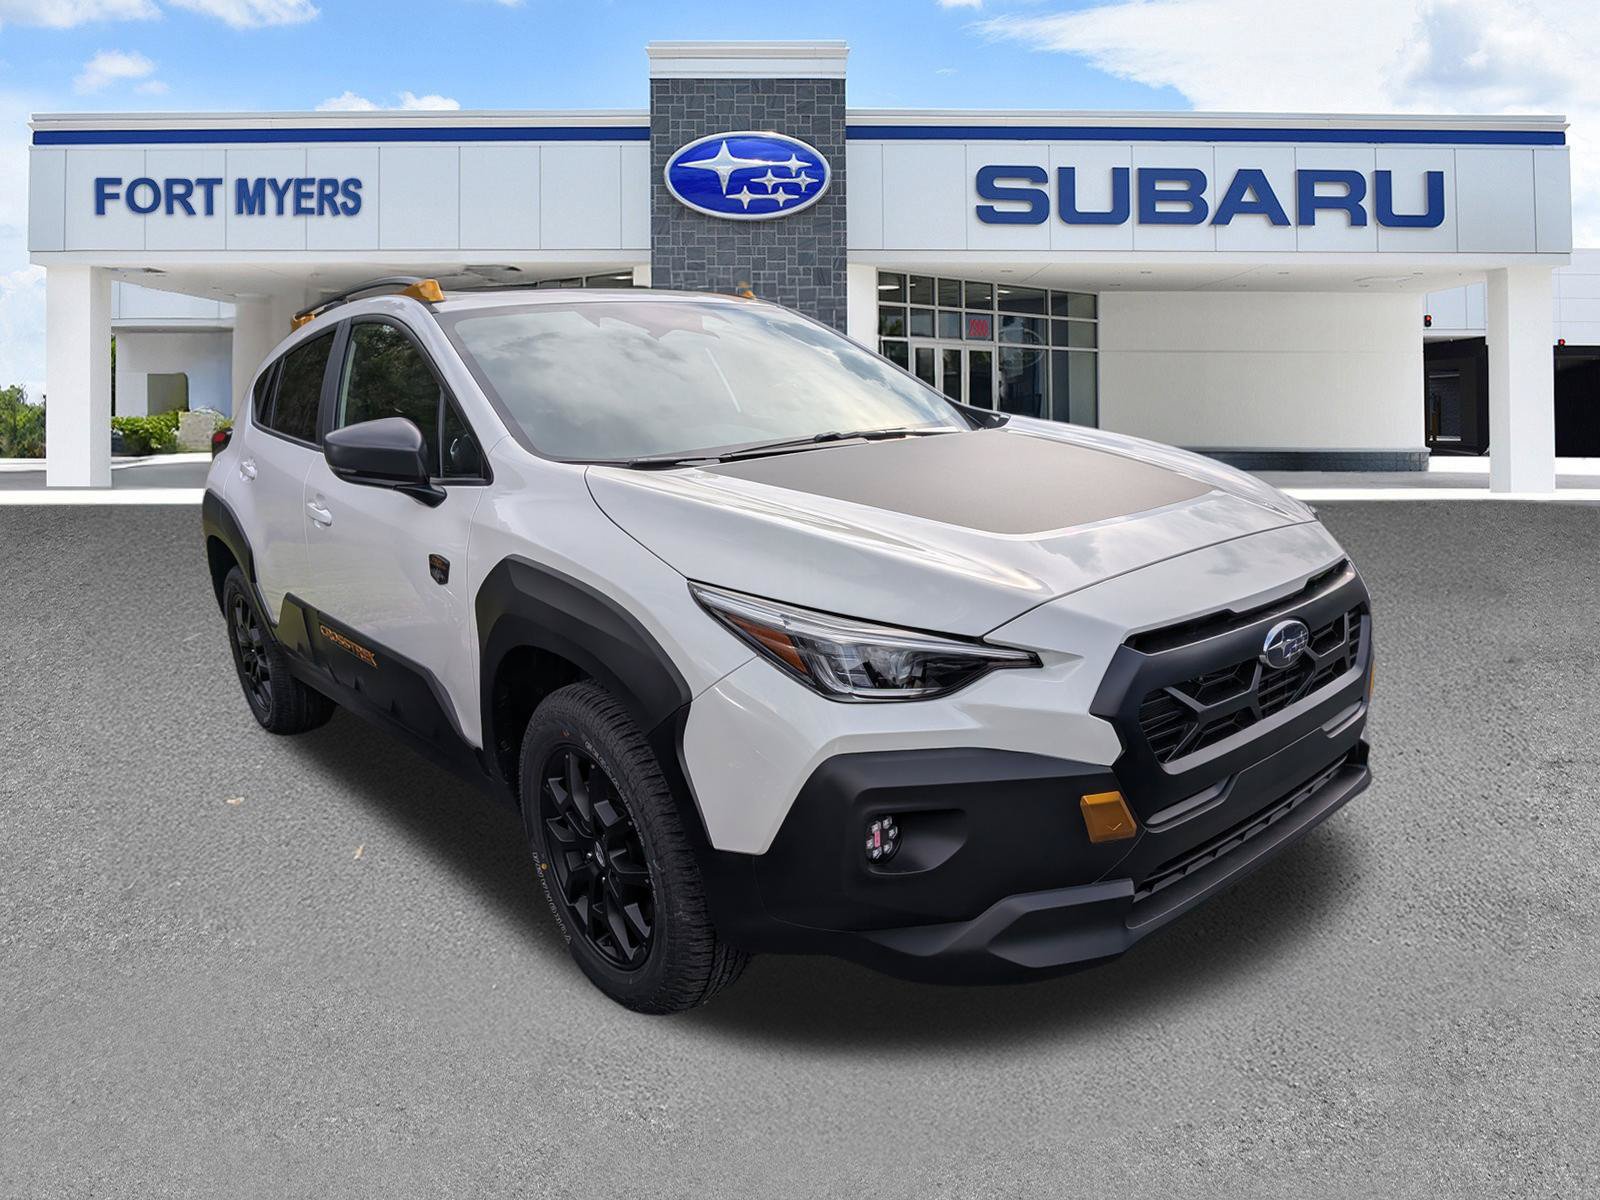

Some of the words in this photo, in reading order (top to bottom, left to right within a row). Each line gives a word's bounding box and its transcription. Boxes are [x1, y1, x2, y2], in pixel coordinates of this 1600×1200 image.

[94, 177, 223, 217] FORT
[235, 178, 363, 216] MYERS
[976, 164, 1445, 229] SUBARU
